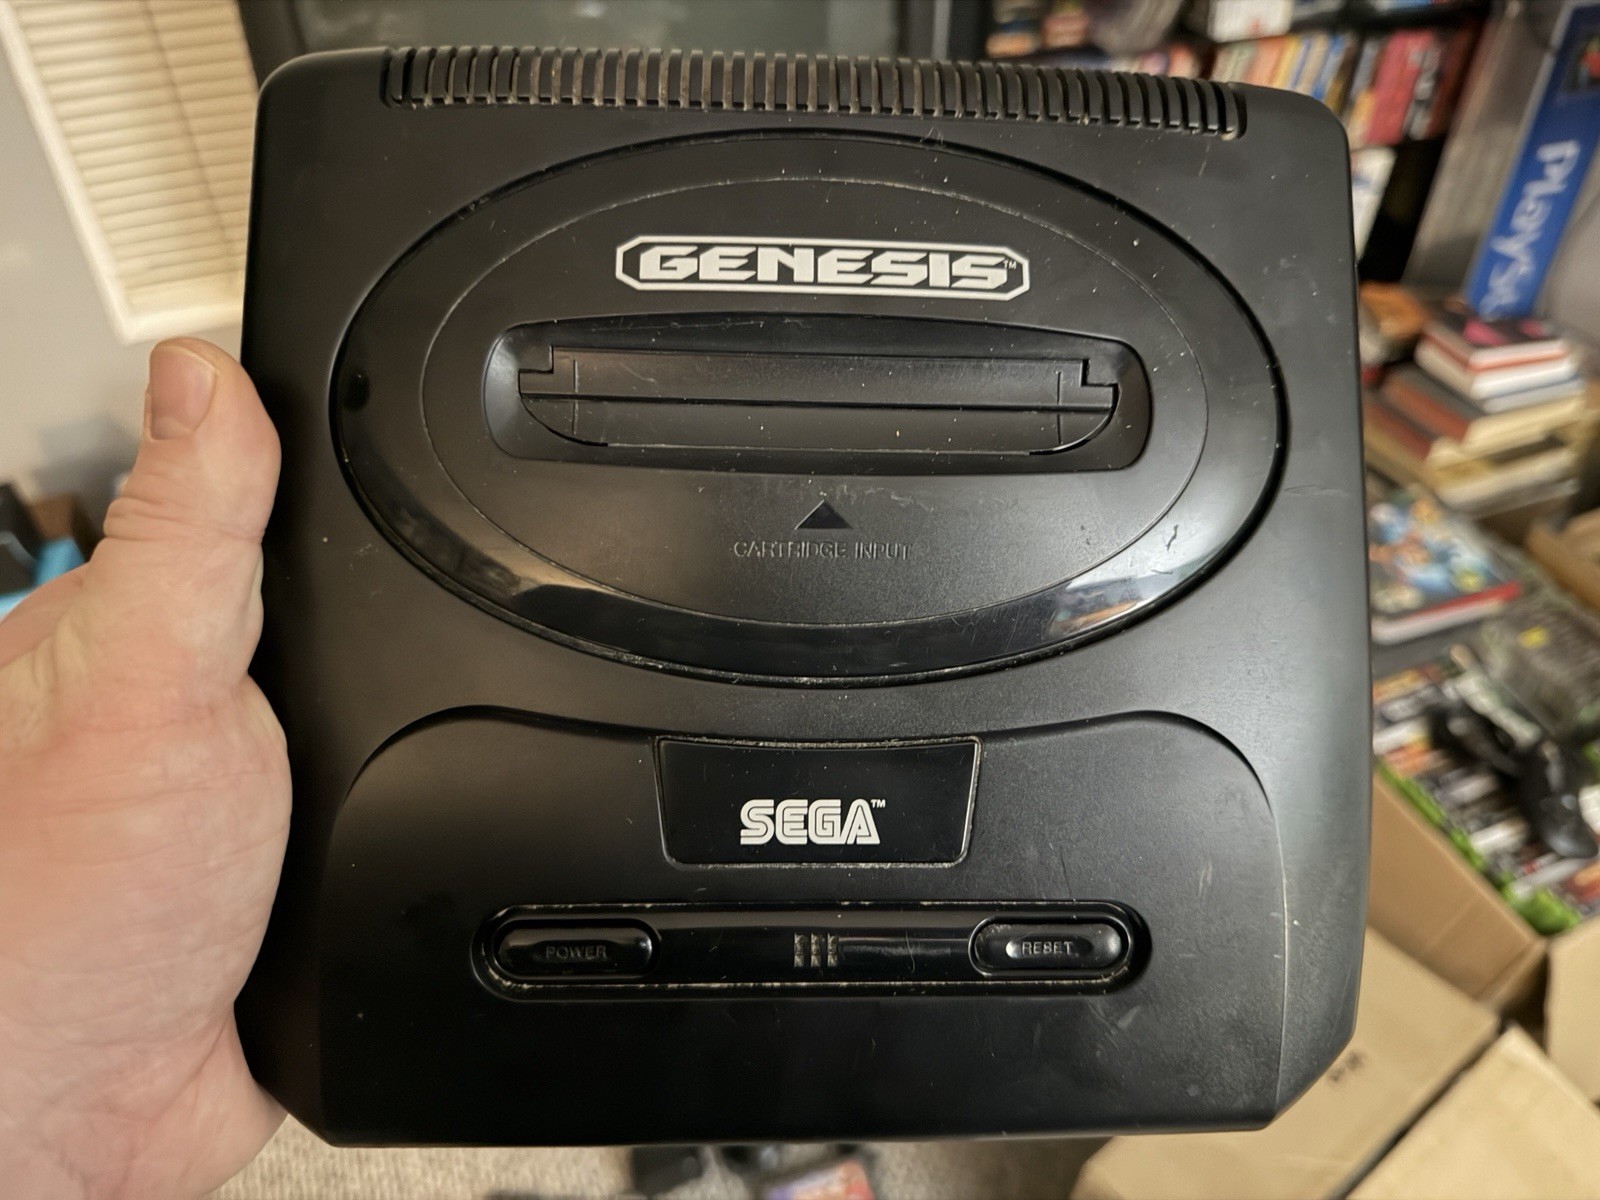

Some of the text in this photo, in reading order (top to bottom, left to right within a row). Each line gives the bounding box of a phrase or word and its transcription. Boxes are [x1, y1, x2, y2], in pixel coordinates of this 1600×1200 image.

[639, 245, 1008, 290] GENESIS
[733, 541, 912, 560] CARTRIDGE INPUT
[740, 798, 881, 845] SEGA
[545, 945, 608, 960] POWER
[1021, 941, 1074, 956] RESET
